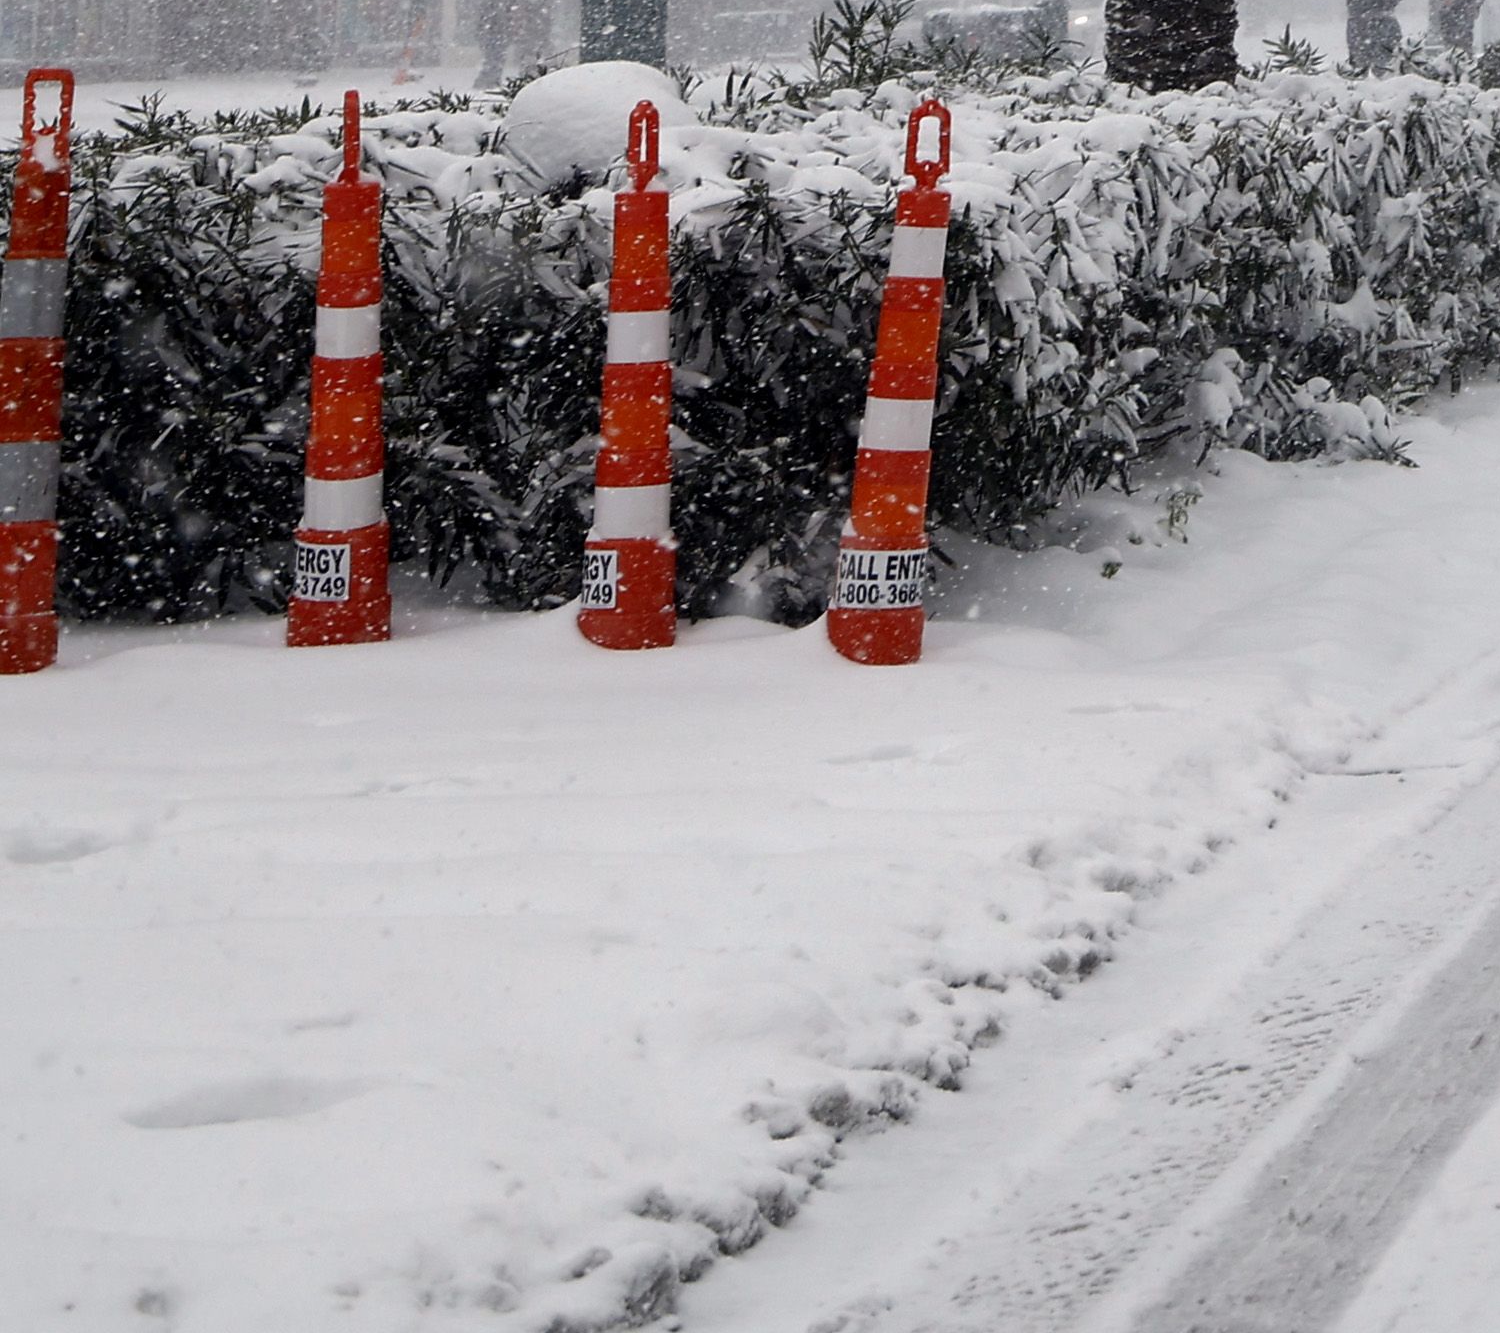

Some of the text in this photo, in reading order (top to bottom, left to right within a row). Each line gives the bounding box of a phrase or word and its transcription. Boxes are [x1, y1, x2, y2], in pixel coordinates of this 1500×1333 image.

[296, 546, 346, 574] ERGY
[840, 553, 878, 581] CALL
[581, 583, 613, 604] 749
[837, 583, 922, 605] 1-800-368-
